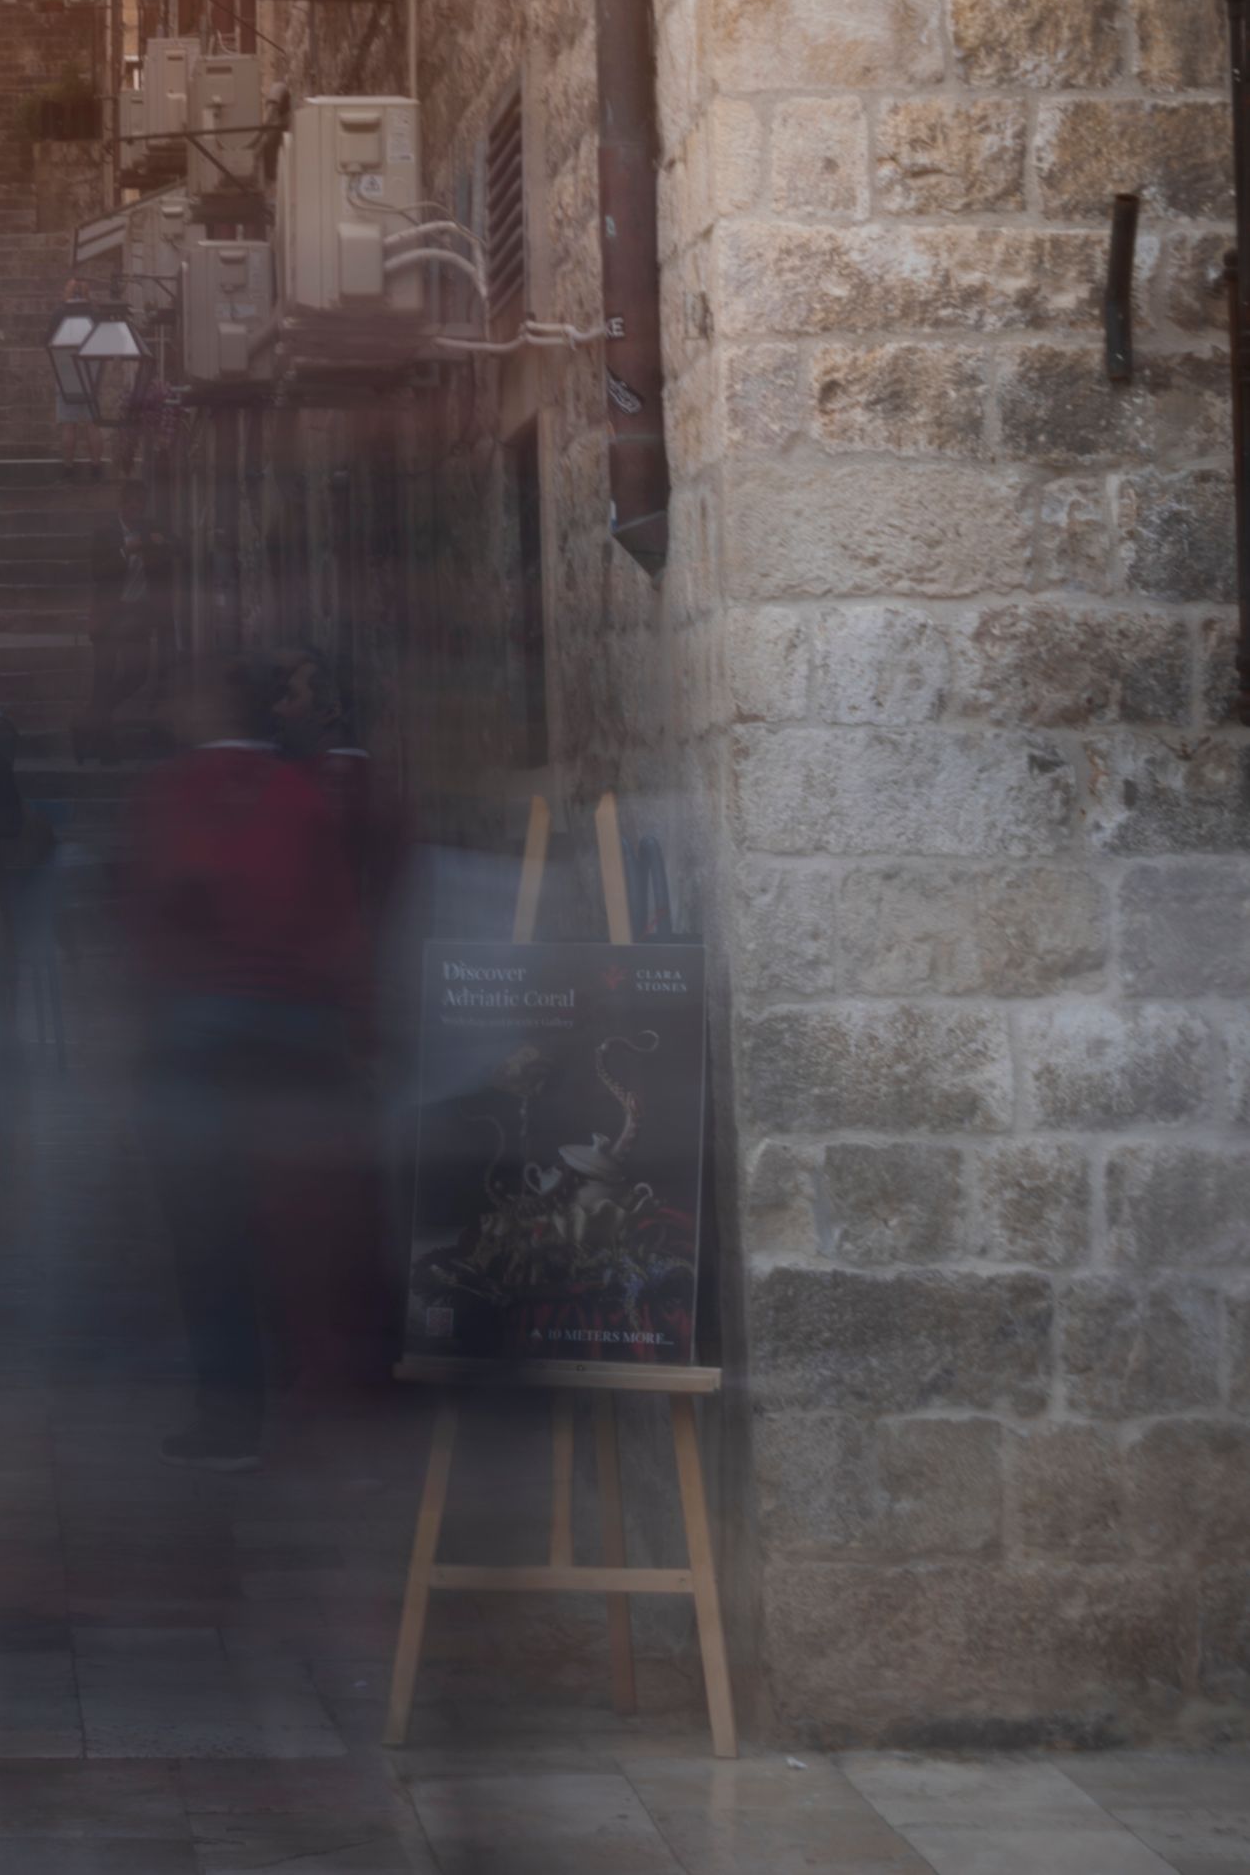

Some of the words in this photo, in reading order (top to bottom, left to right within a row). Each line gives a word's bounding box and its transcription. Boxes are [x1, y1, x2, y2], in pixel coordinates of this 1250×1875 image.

[442, 960, 527, 982] Discover
[635, 969, 682, 980] CLARA
[635, 981, 687, 993] STONES
[440, 987, 519, 1007] Adriatic
[523, 988, 575, 1008] Coral
[564, 1329, 620, 1343] METERS
